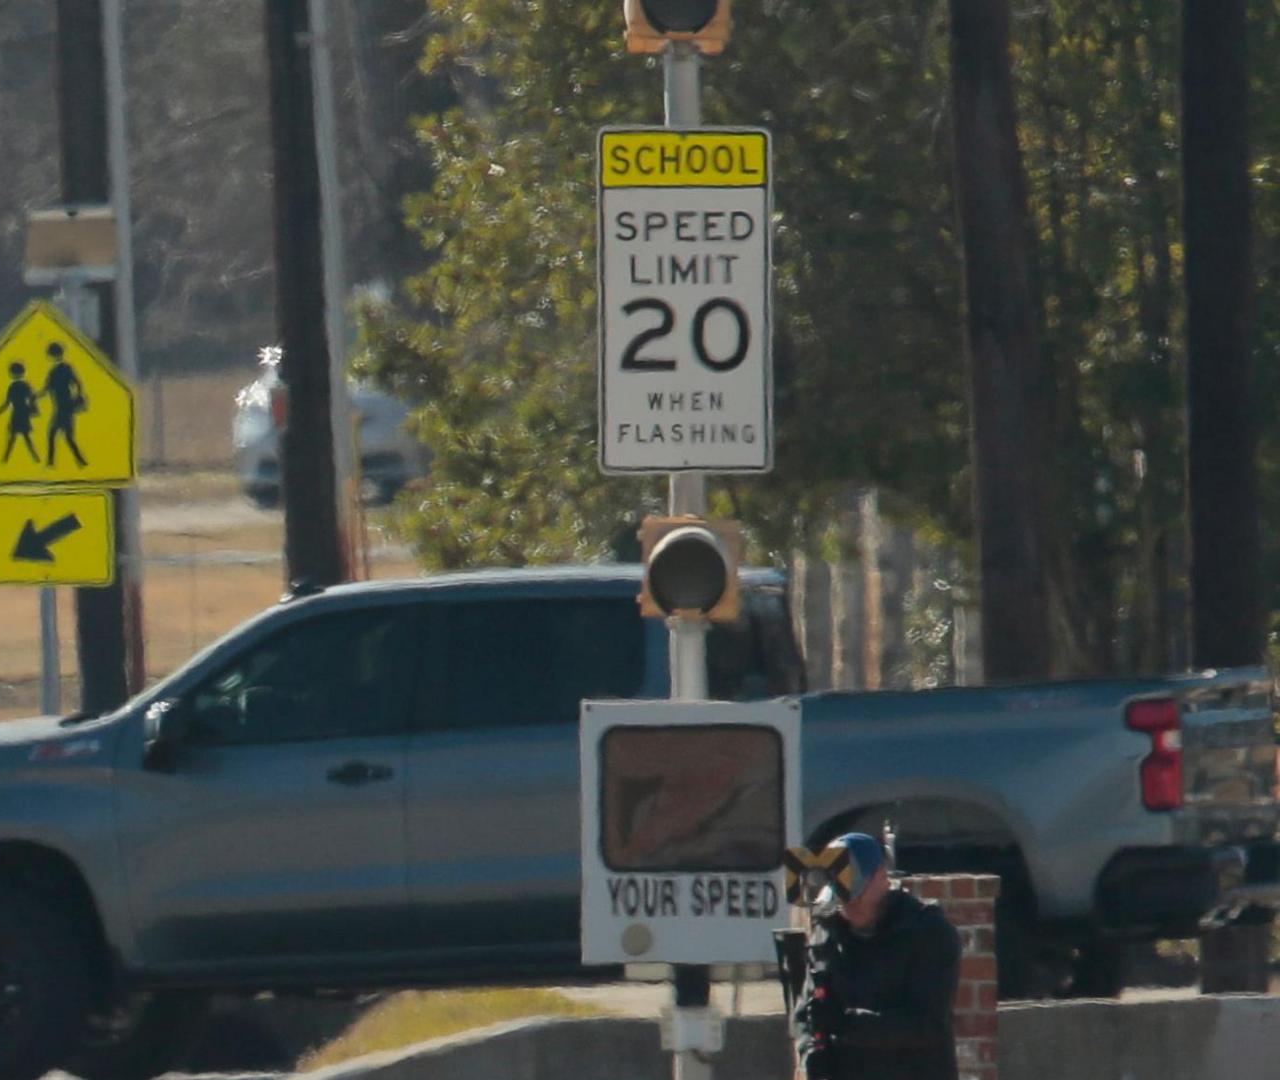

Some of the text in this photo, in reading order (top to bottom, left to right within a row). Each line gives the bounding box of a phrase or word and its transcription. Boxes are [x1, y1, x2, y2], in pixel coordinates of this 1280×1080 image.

[610, 144, 759, 175] SCHOOL
[615, 211, 754, 242] SPEED
[630, 253, 739, 285] LIMIT
[620, 296, 752, 374] 20
[647, 392, 724, 411] WHEN
[617, 423, 755, 444] FLASHING
[606, 877, 779, 919] YOUR SPEED
